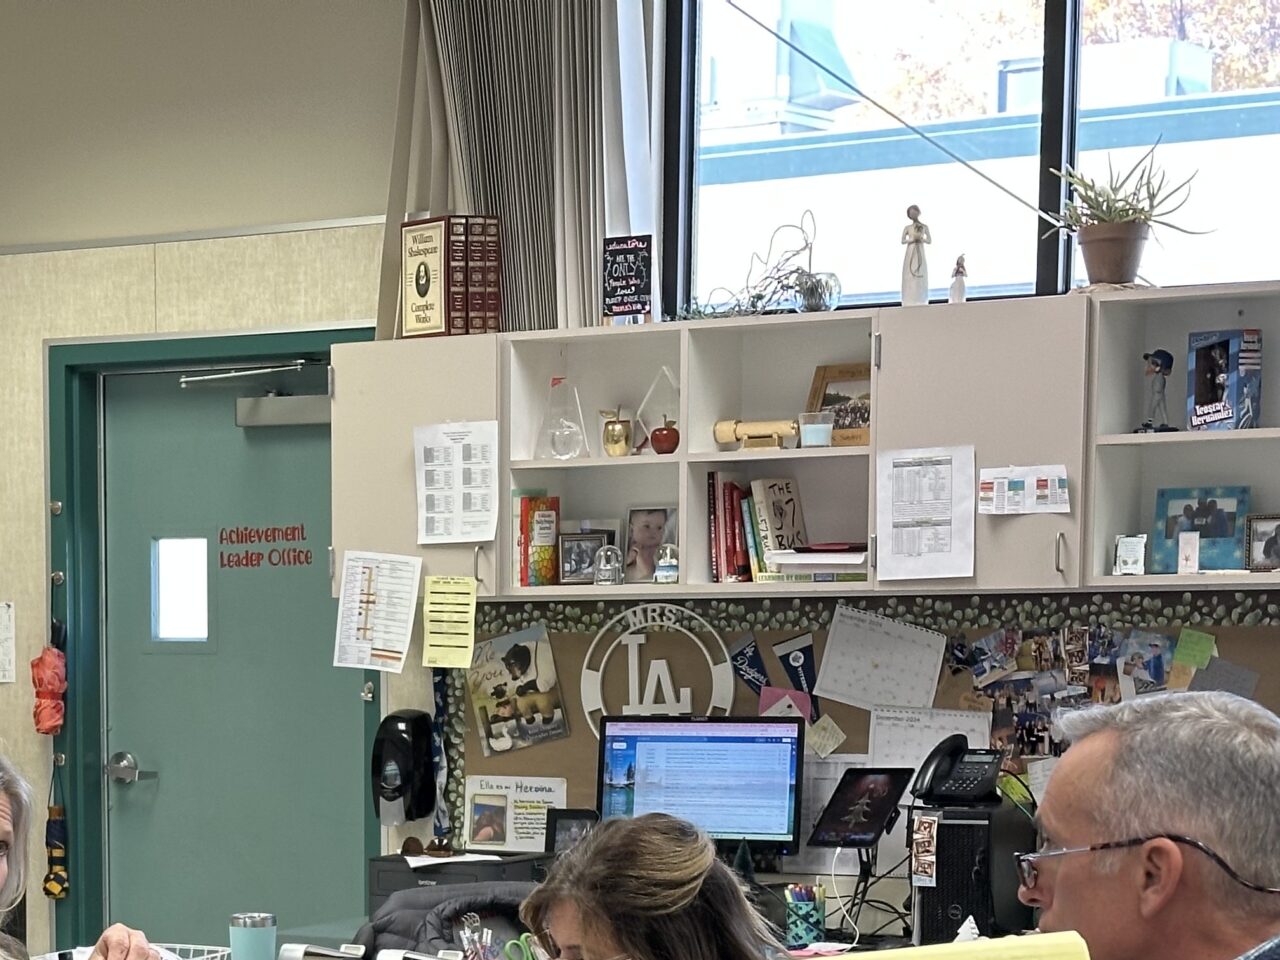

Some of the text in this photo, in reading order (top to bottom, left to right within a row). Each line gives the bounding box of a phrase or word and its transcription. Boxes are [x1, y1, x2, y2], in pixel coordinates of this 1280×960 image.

[411, 233, 434, 245] William
[612, 261, 639, 277] ONLY
[410, 300, 435, 315] Complete
[414, 314, 432, 324] Works
[768, 482, 793, 496] THE
[219, 523, 307, 545] Achievement
[775, 531, 804, 551] BUS
[220, 547, 313, 569] Leader Office
[620, 633, 692, 716] LA
[732, 655, 769, 686] Dodgers
[480, 779, 494, 790] Ella
